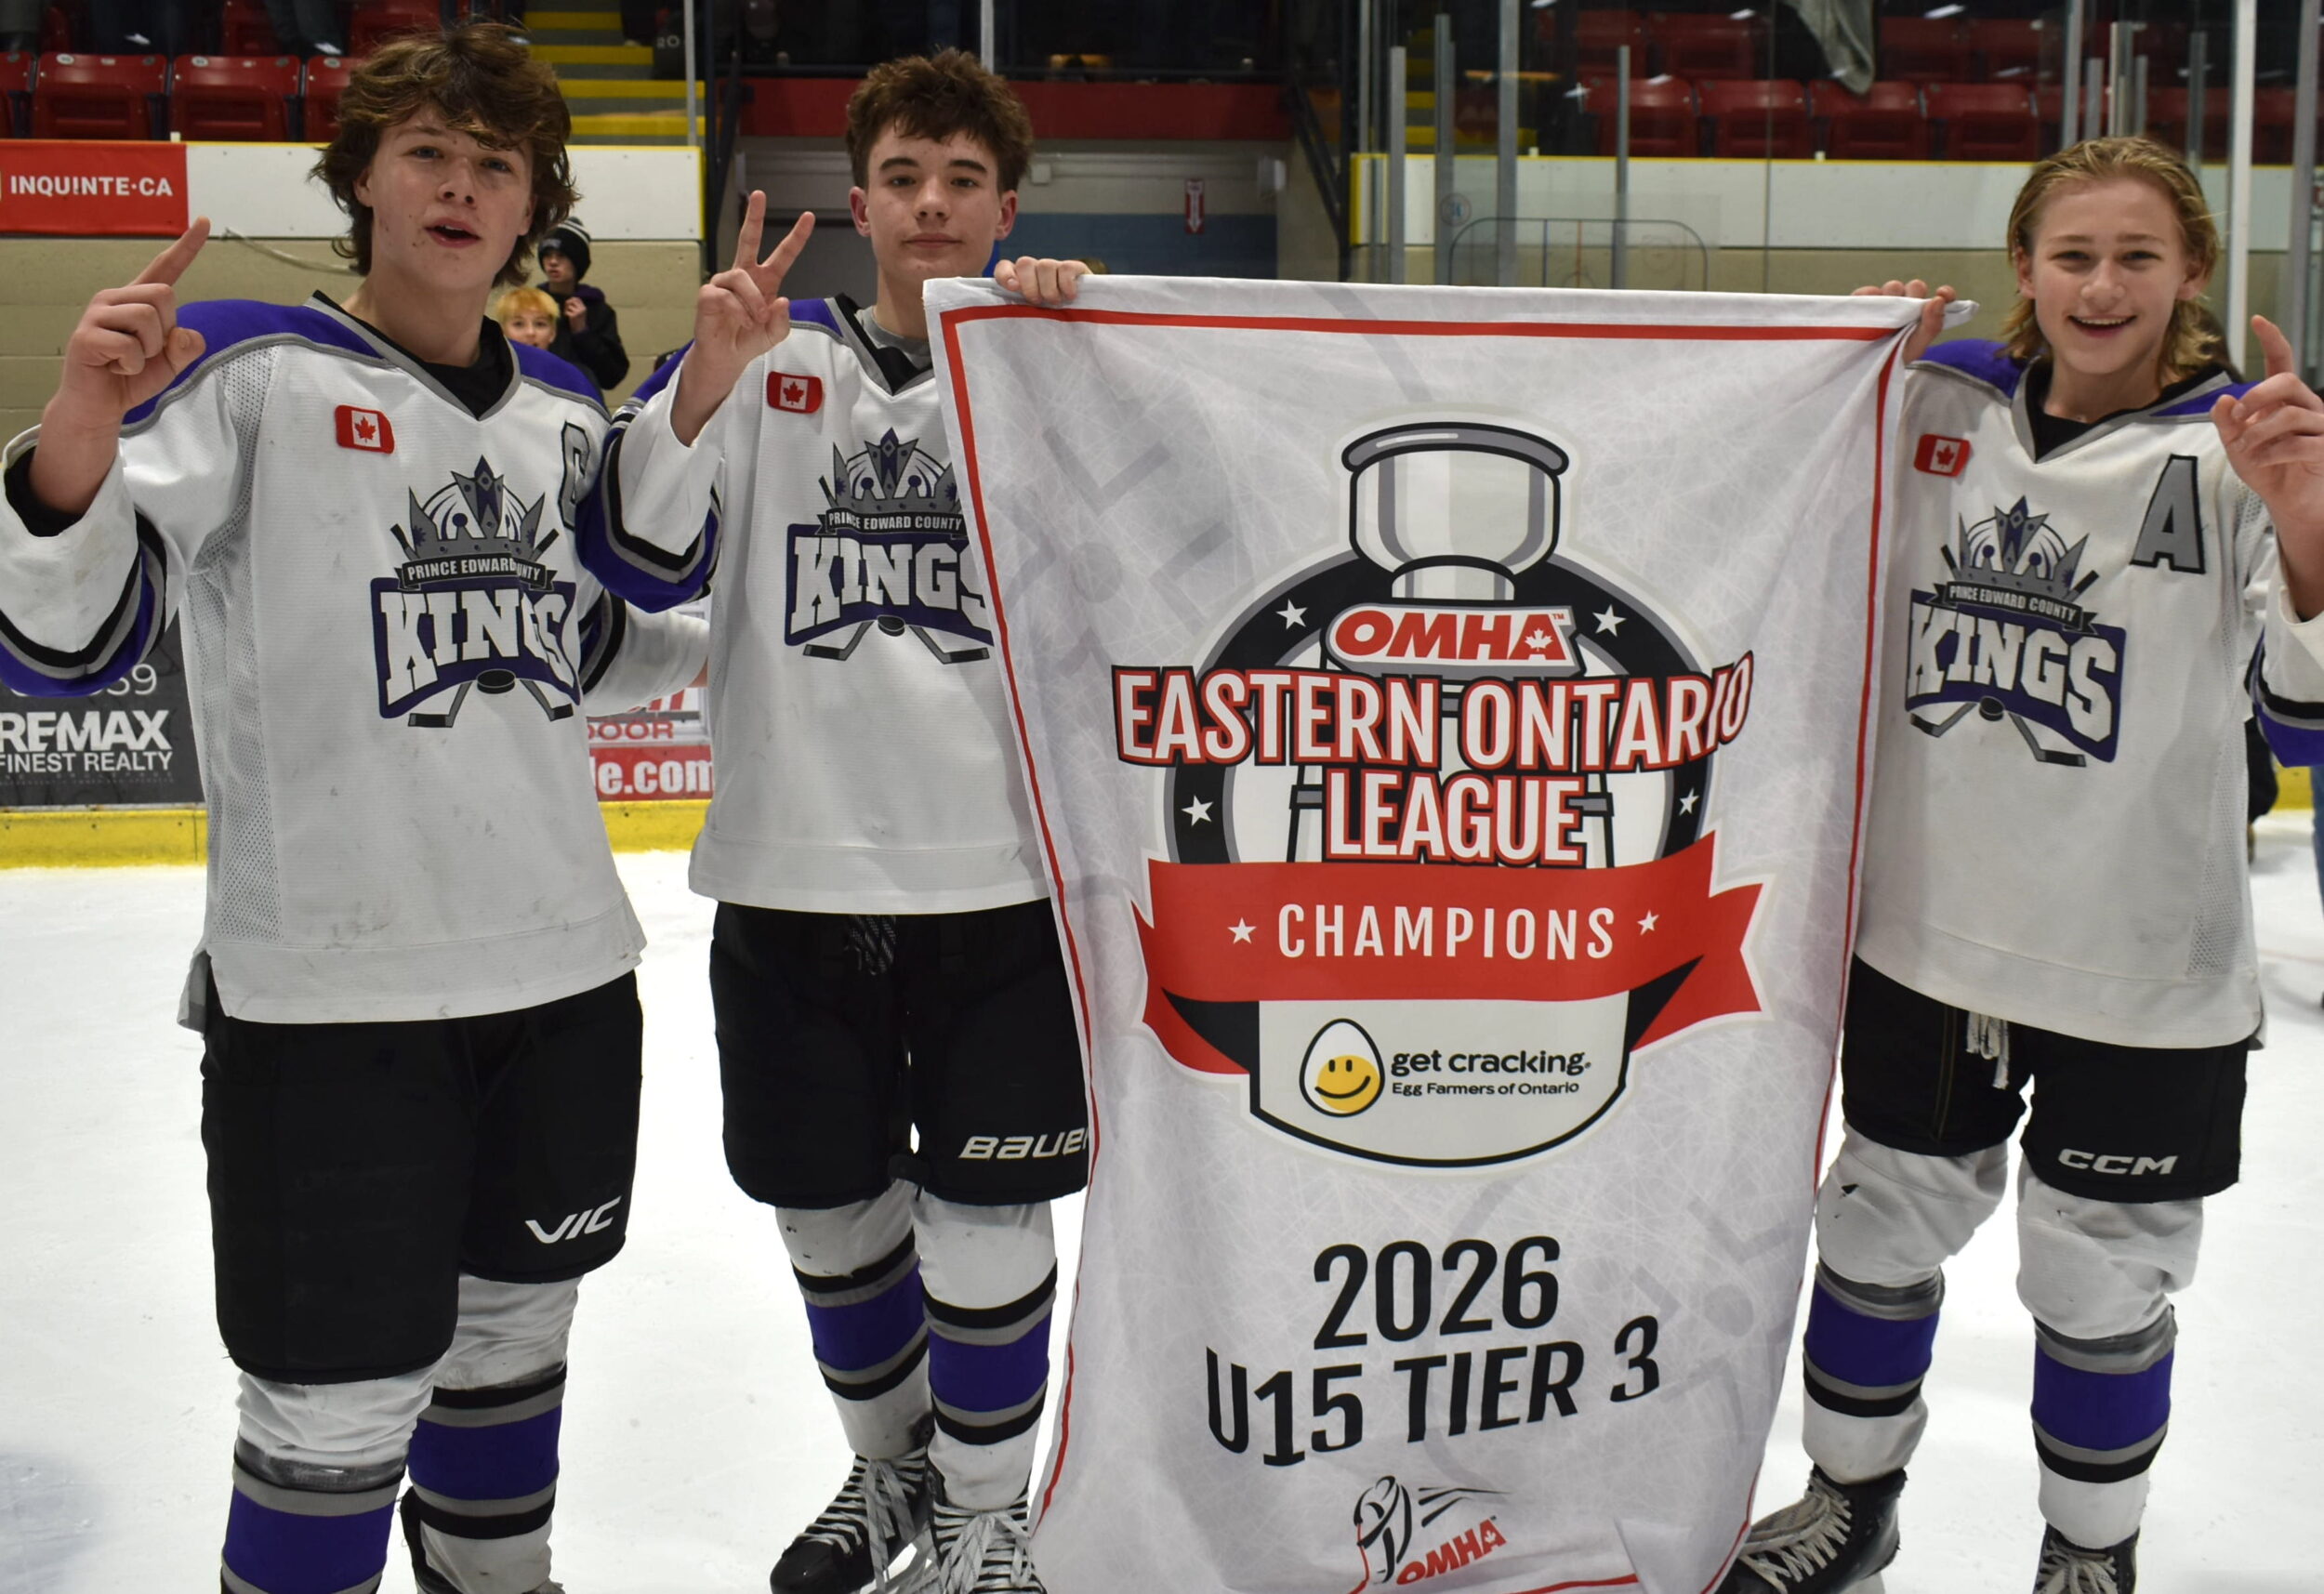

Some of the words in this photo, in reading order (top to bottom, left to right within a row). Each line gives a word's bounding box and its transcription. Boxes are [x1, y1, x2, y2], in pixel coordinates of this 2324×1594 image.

[828, 512, 860, 528] PRINCE
[864, 516, 912, 531] EDWARD
[915, 515, 962, 531] COUNTY
[2129, 454, 2207, 574] A
[407, 560, 458, 581] PRINCE
[1980, 588, 2027, 609] EDWARD
[2028, 598, 2077, 622] COUNTY
[1333, 610, 1566, 661] OMHA
[1908, 602, 2117, 744] KINGS
[1114, 666, 1439, 769] EASTERN
[1461, 652, 1753, 772] ONTARIO
[84, 751, 173, 772] REALTY
[589, 756, 713, 795] e.com
[1326, 770, 1584, 864] LEAGUE
[1278, 903, 1615, 960] CHAMPIONS
[1391, 1049, 1442, 1077] get
[1393, 1082, 1422, 1097] Egg
[1427, 1082, 1495, 1095] Farmers
[1498, 1083, 1515, 1095] of
[1518, 1082, 1579, 1095] Ontario
[2058, 1148, 2178, 1176] CCM
[524, 1195, 622, 1244] VIC
[1314, 1235, 1560, 1350] 2026
[1206, 1345, 1364, 1467] U15
[1393, 1341, 1584, 1443] TIER
[1609, 1315, 1660, 1403] 3
[1396, 1519, 1507, 1586] OMHA
